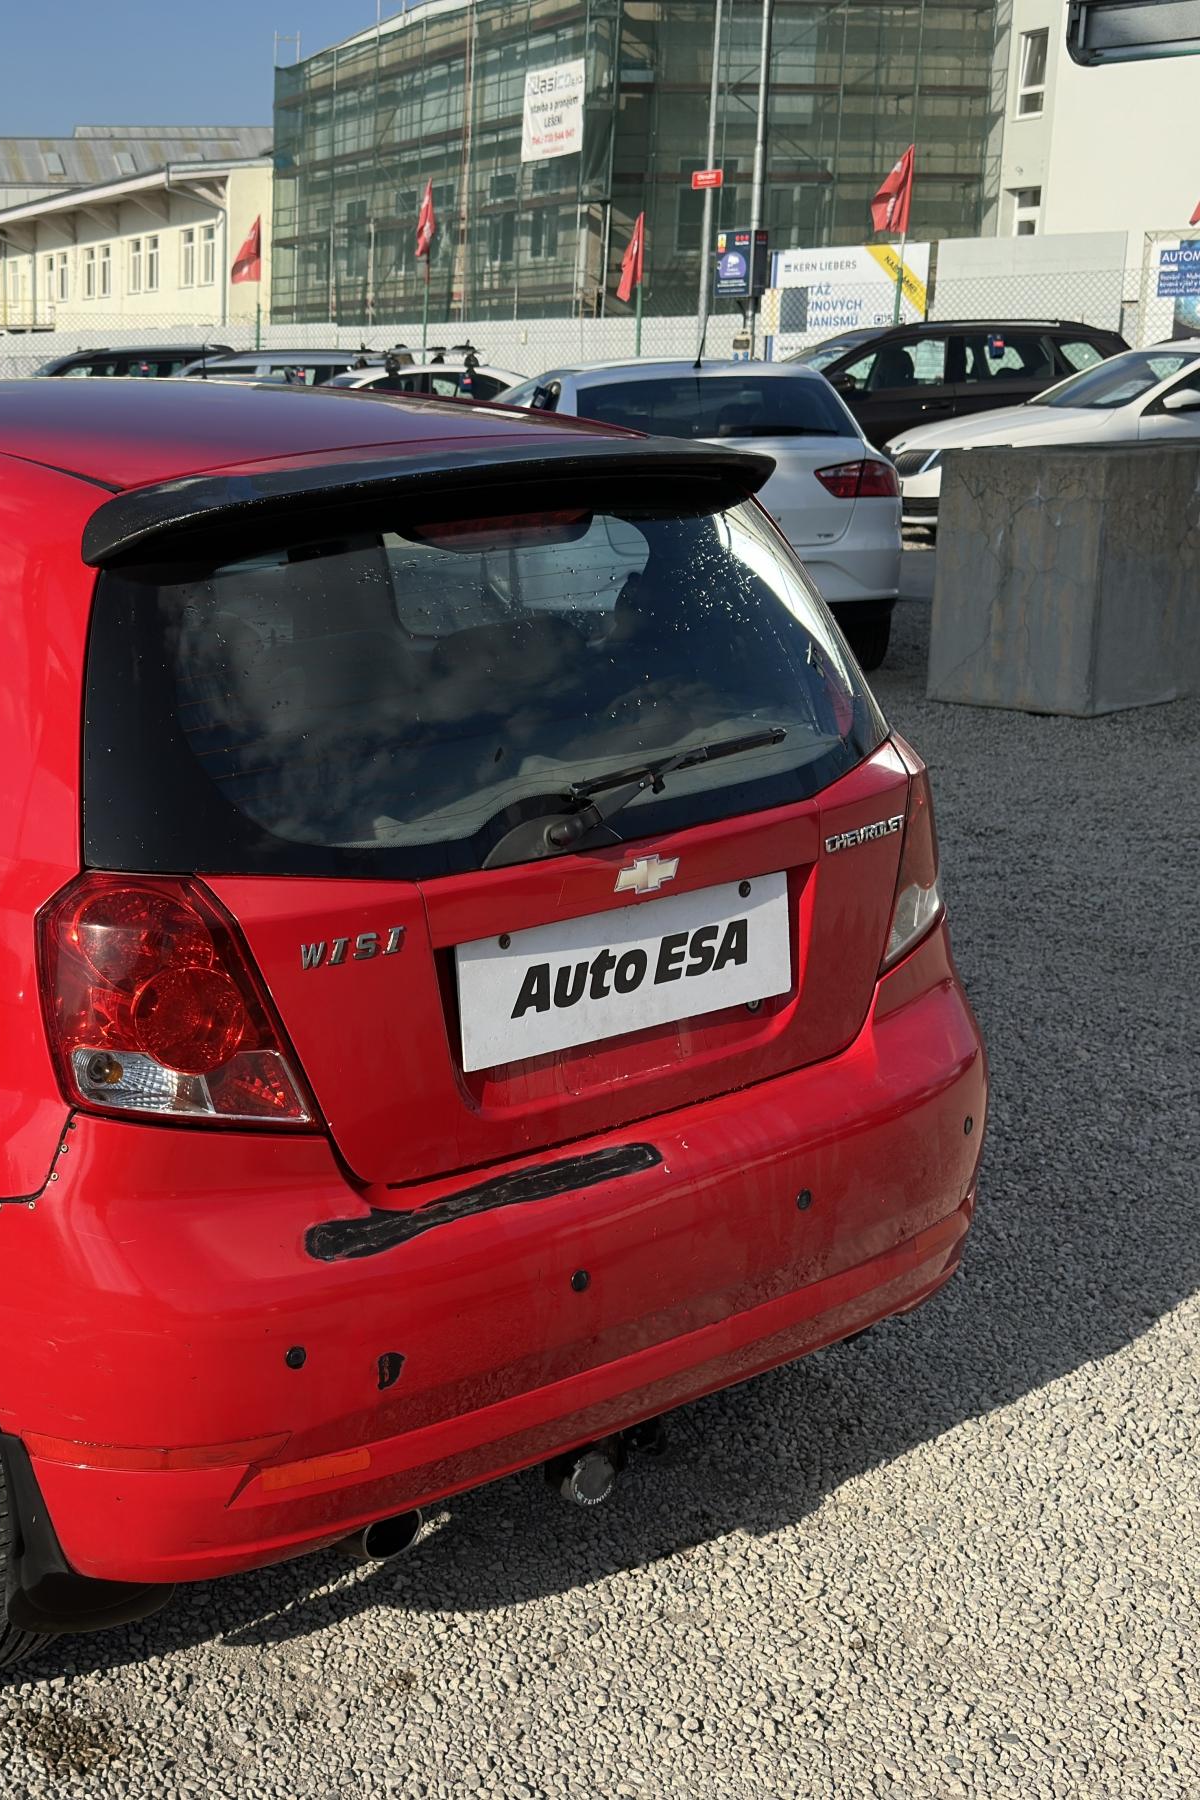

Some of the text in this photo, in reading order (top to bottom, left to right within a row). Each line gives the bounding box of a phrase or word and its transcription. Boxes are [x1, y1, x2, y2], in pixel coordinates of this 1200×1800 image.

[793, 260, 857, 272] KERN LIEBERS
[825, 814, 905, 853] CHEVROLET
[300, 925, 405, 971] WISI
[510, 918, 748, 1019] Auto ESA
